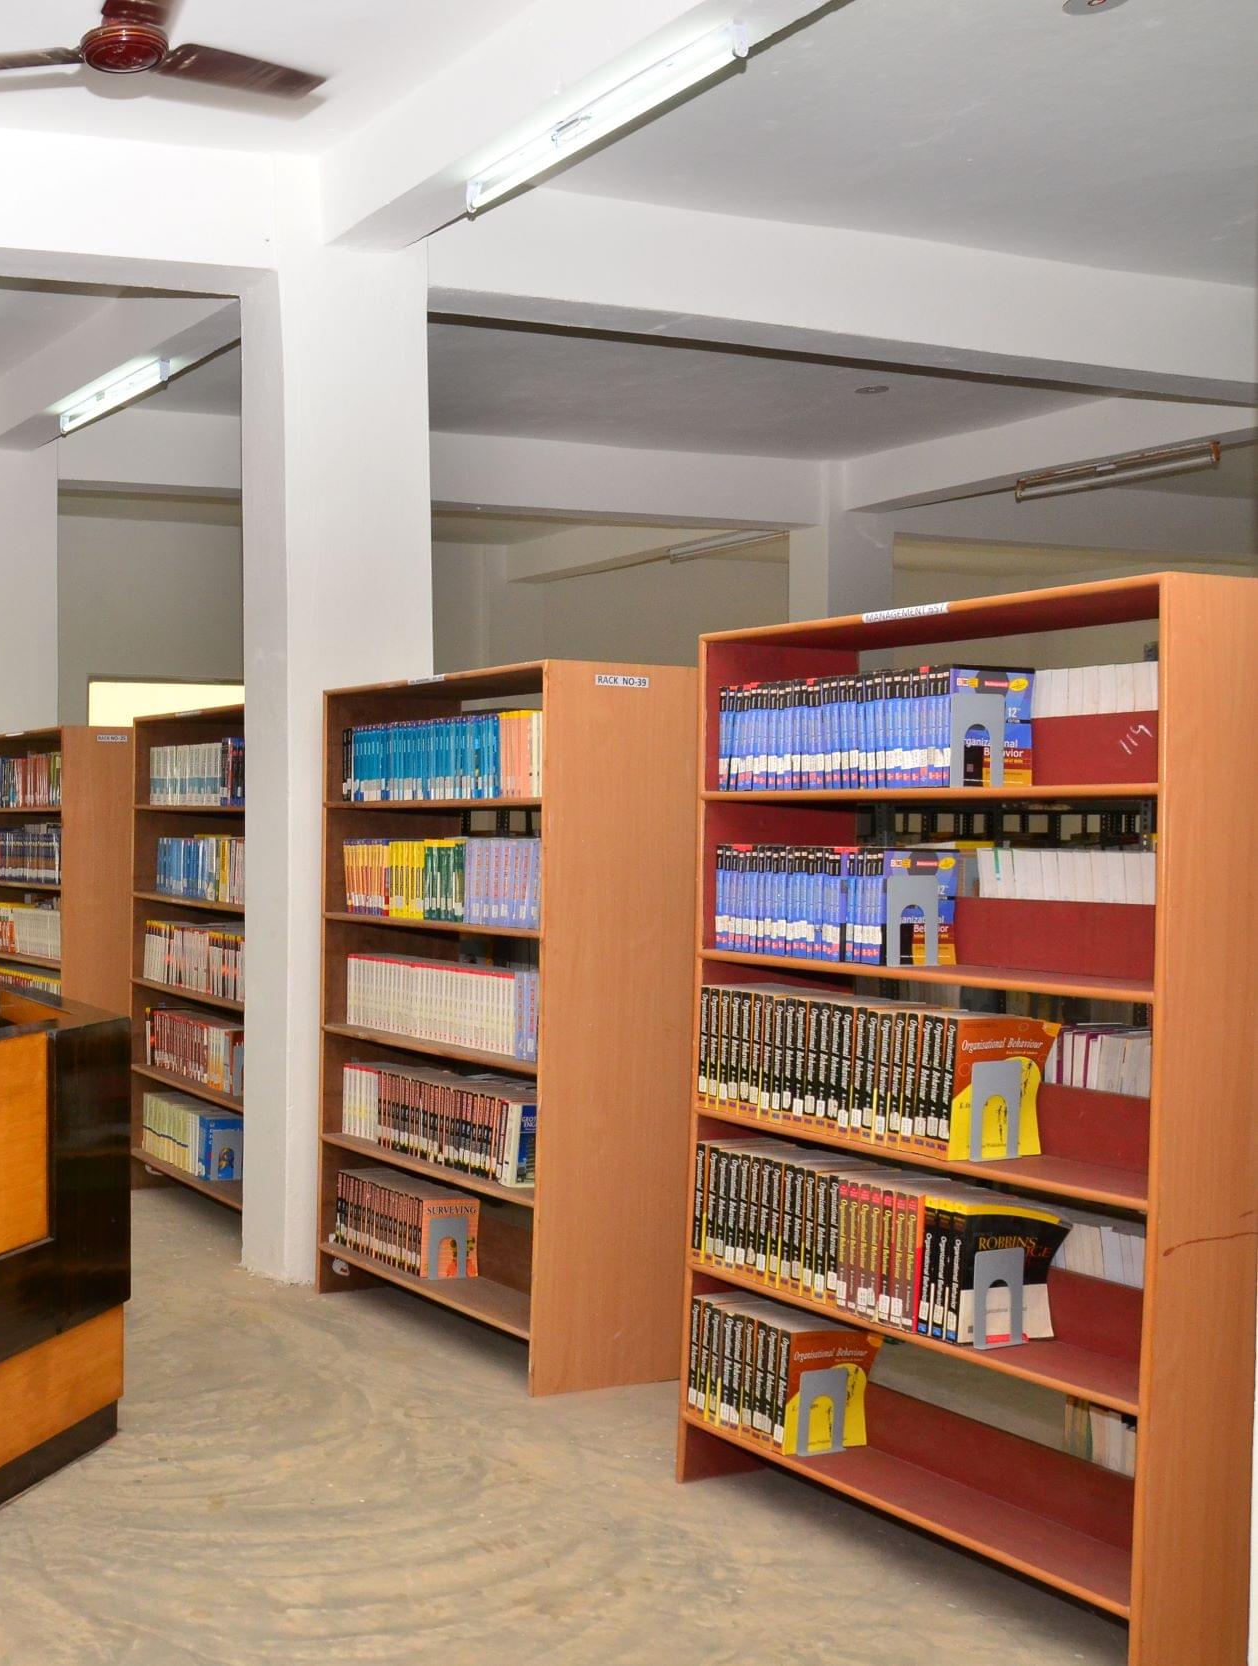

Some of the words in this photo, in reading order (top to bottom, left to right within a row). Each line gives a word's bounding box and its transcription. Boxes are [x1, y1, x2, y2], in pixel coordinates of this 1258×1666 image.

[597, 675, 618, 685] RACK
[622, 677, 646, 686] NO-39
[961, 1037, 1005, 1053] Organisational
[1007, 1037, 1043, 1049] Behaviour
[427, 1205, 476, 1215] SURVEYING
[979, 1235, 1037, 1250] ROBBINS
[951, 1283, 959, 1309] Behavior
[794, 1348, 835, 1362] Organisational
[836, 1347, 868, 1357] Behaviour
